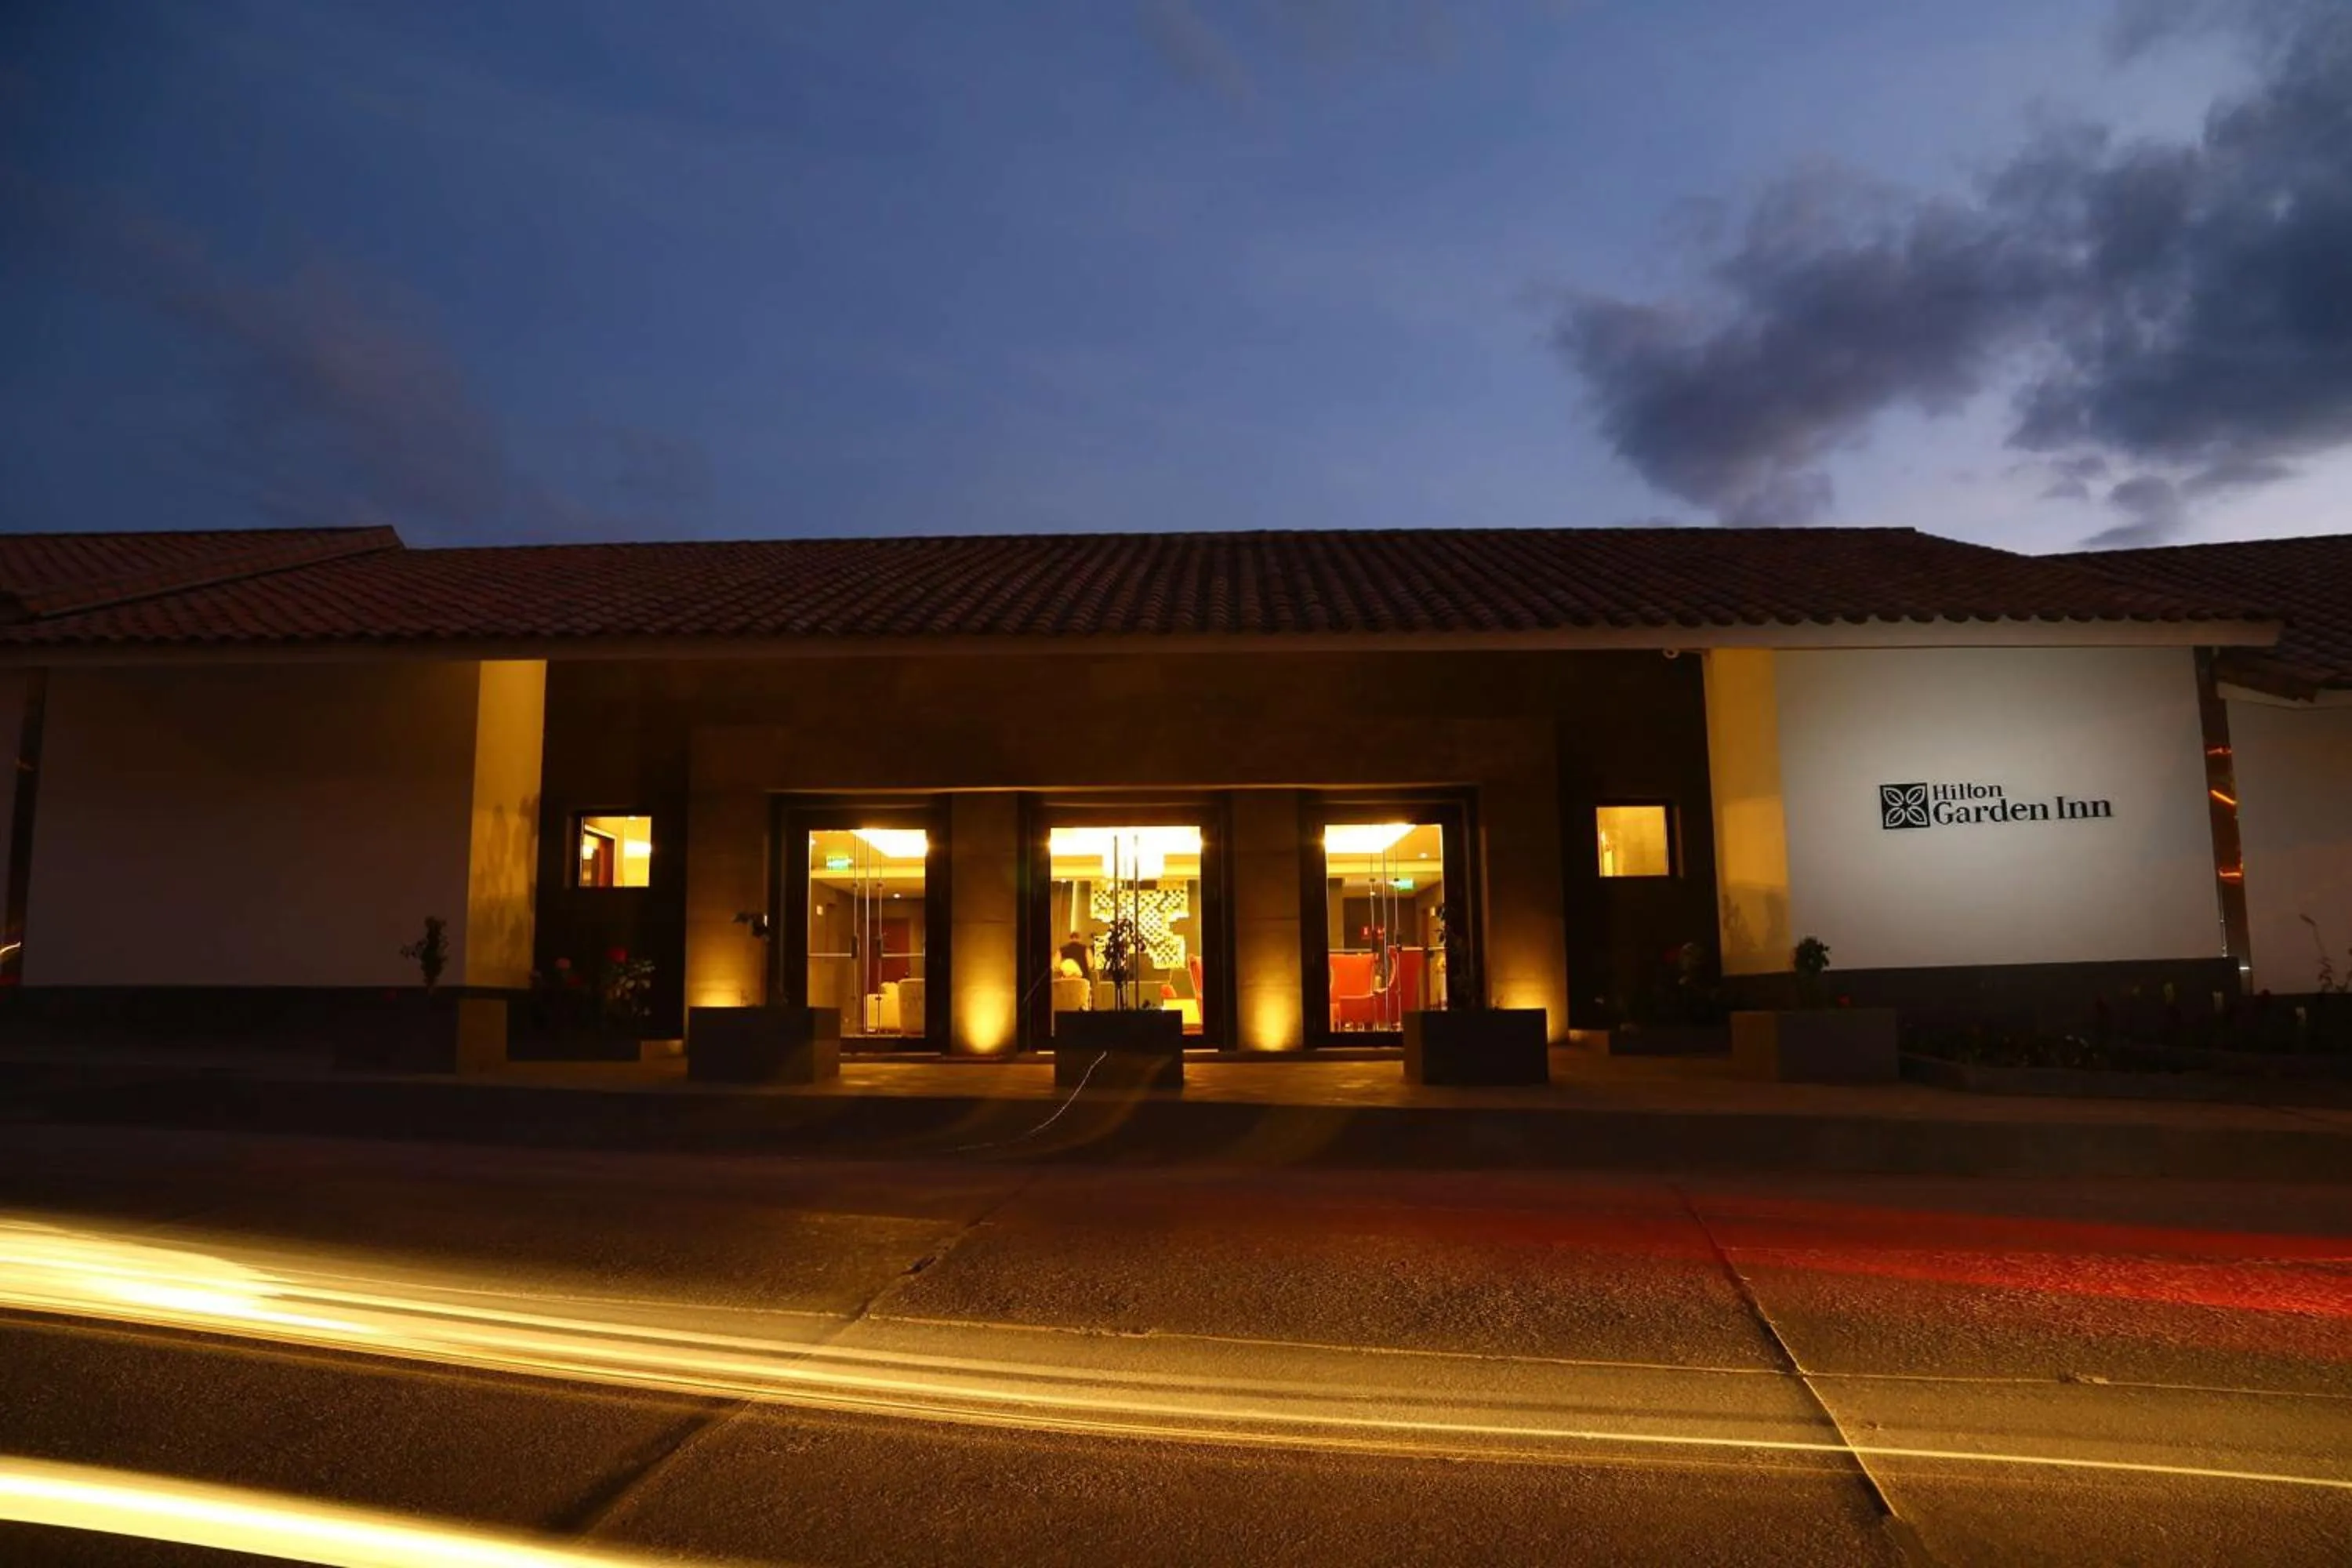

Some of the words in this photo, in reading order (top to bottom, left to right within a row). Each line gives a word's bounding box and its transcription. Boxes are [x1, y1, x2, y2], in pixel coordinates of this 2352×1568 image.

[1933, 782, 2003, 800] Hilton
[1933, 798, 2049, 825] Garden
[2055, 796, 2113, 819] Inn
